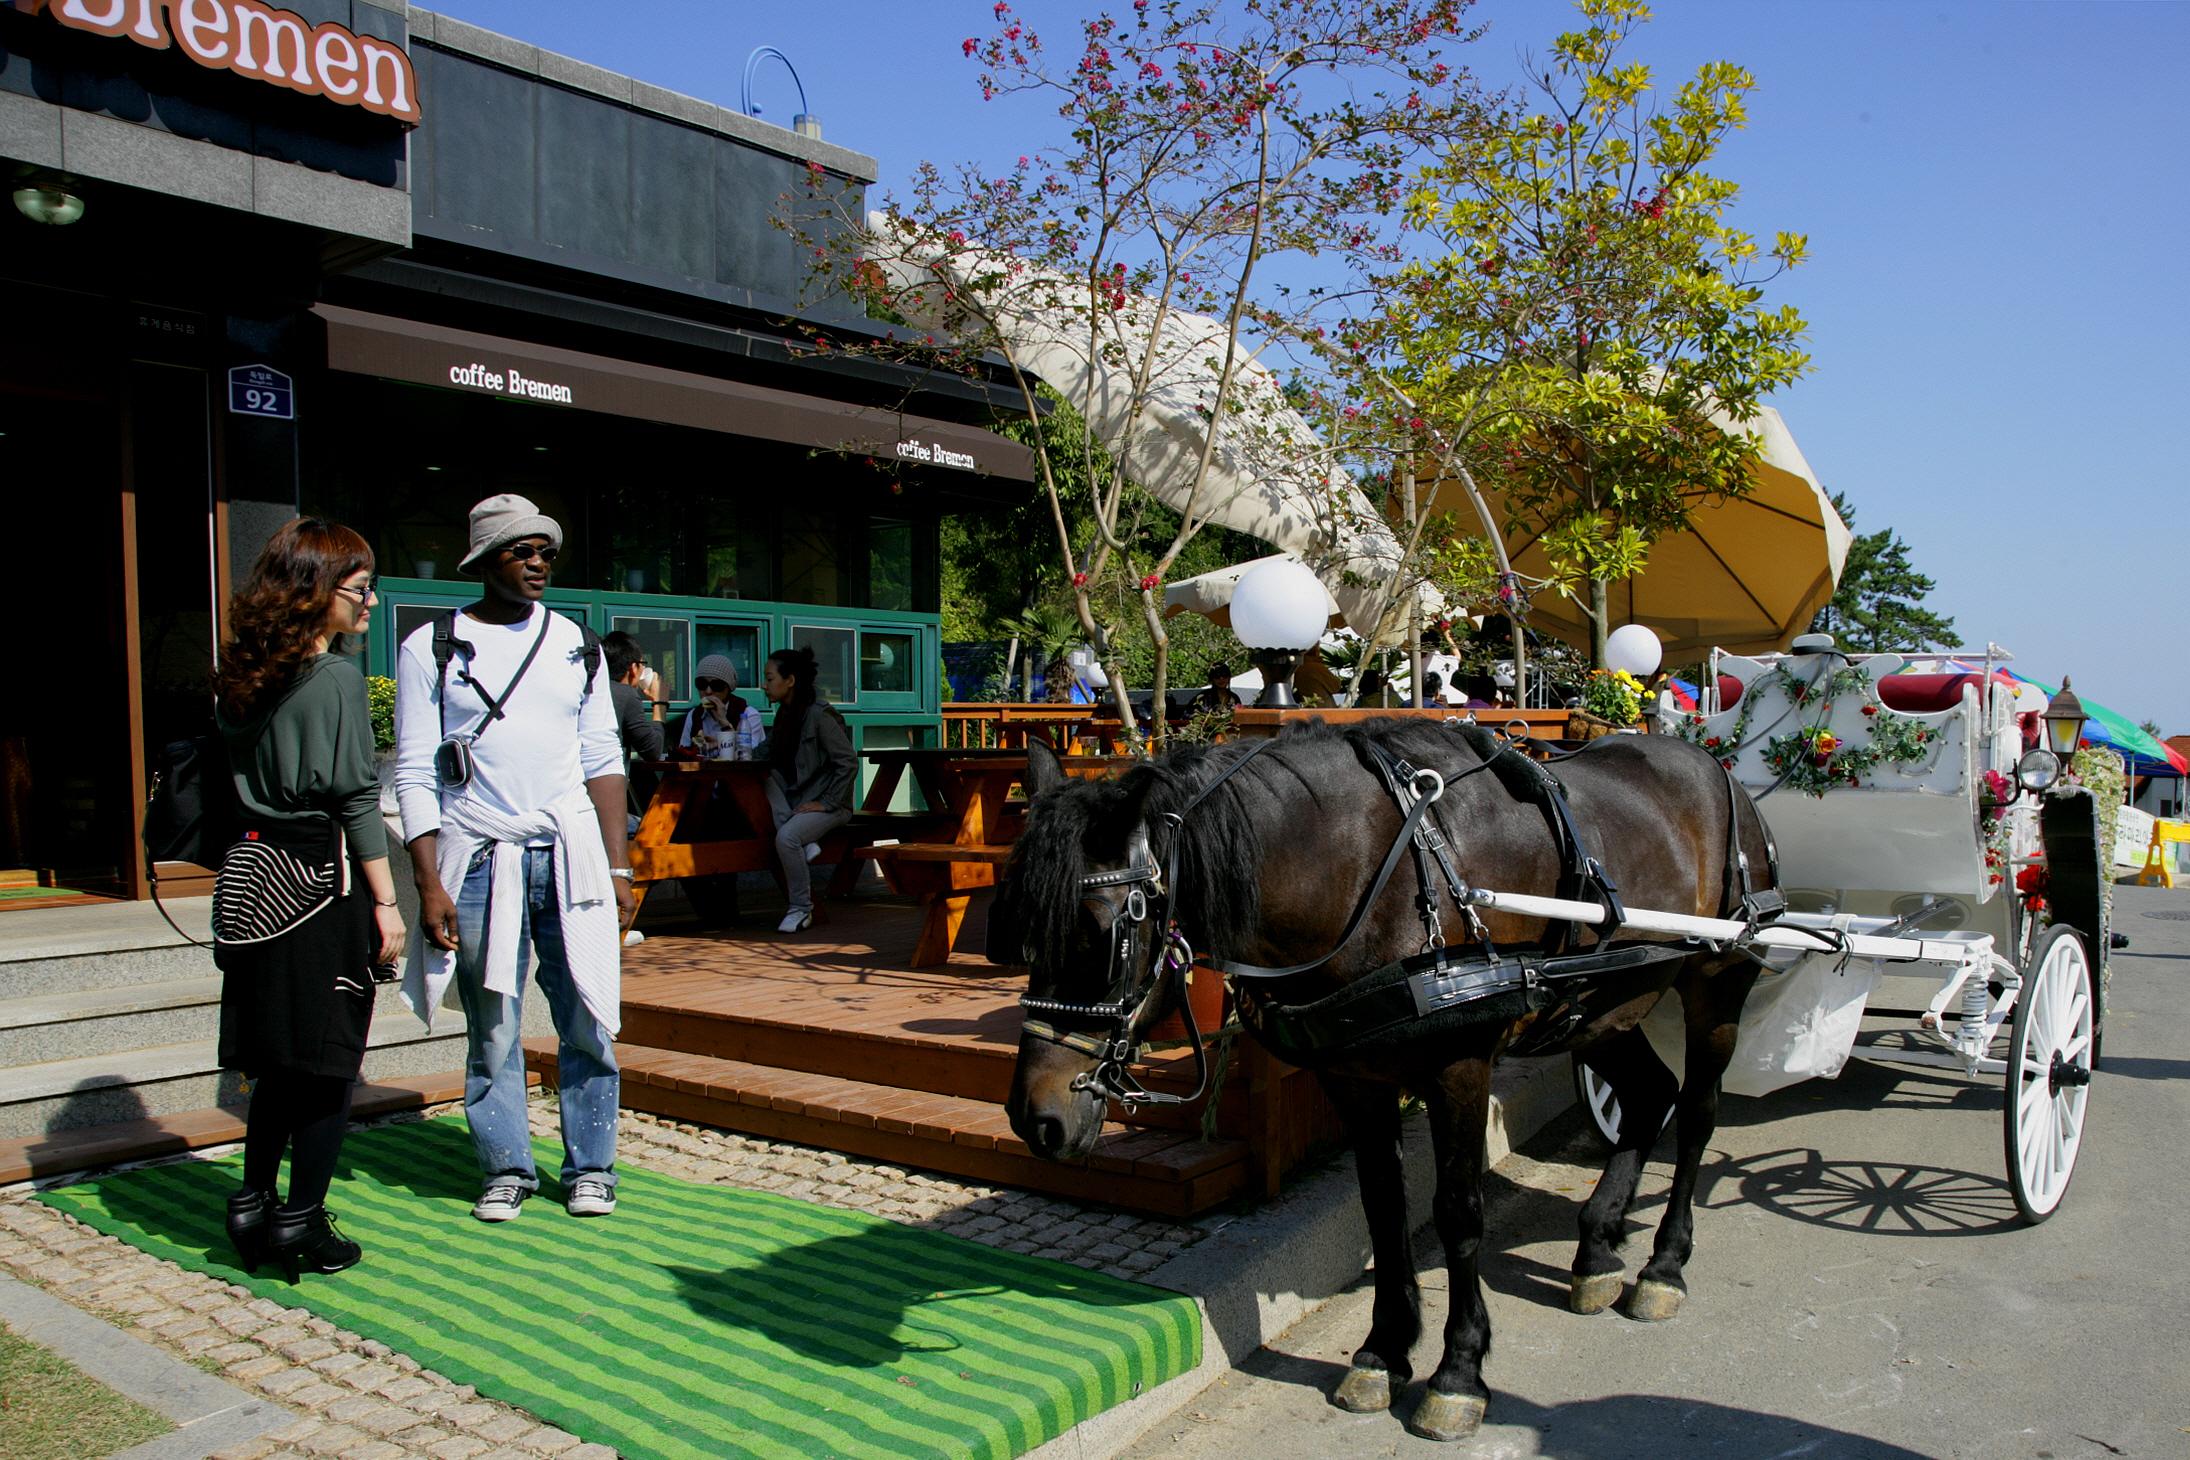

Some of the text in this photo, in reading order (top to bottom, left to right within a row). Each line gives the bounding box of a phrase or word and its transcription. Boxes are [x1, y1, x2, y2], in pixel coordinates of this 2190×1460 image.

[450, 363, 572, 403] coffee Bremen
[246, 389, 278, 412] 92
[897, 440, 931, 461] coffee
